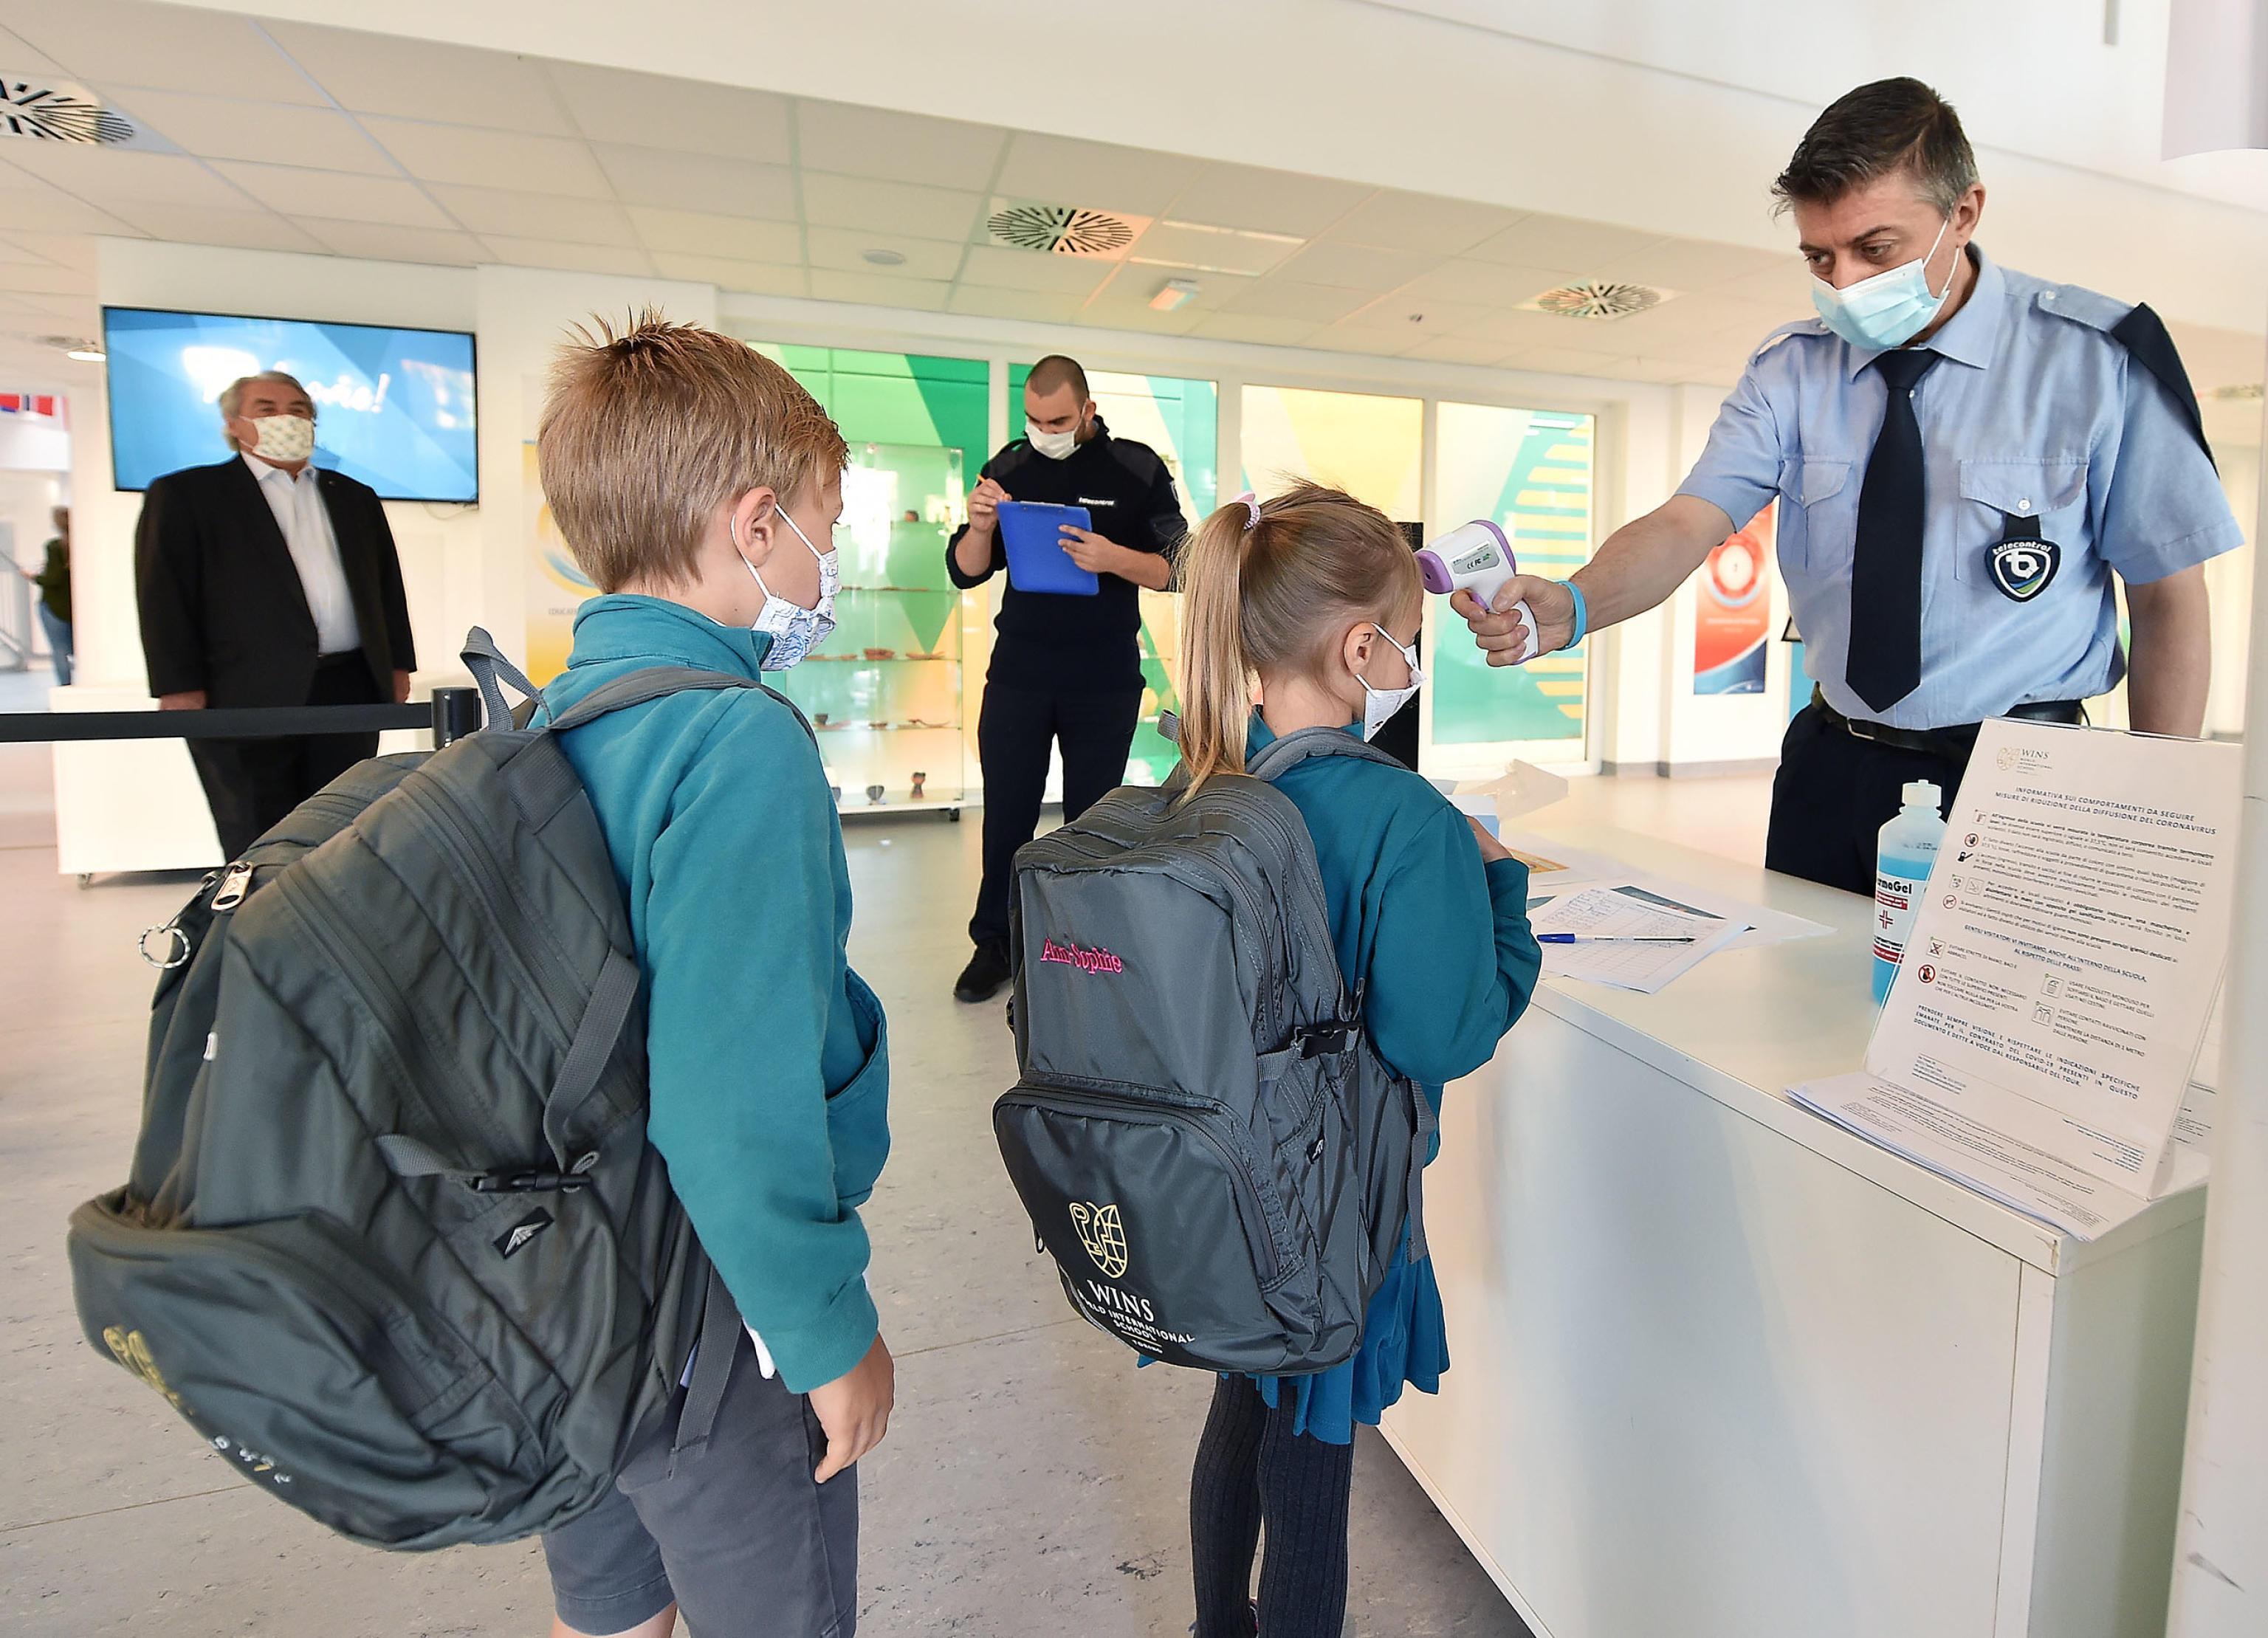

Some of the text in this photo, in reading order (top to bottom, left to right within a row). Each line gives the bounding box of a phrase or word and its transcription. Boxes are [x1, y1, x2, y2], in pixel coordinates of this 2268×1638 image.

[1992, 541, 2052, 555] telecontrol
[2021, 749, 2049, 759] WINS
[1994, 792, 2019, 800] MISURE
[2030, 798, 2067, 808] RIDUZIONE
[2069, 804, 2091, 813] DELLA
[2092, 808, 2137, 821] DIFFUSIONE
[2139, 816, 2154, 824] DEL
[2156, 819, 2216, 834] CORONAVIRUS
[2015, 787, 2063, 799] INFORMATIVA
[2078, 797, 2145, 813] COMPORTAMENTI
[2160, 810, 2195, 821] SEGUIRE
[1040, 937, 1123, 974] Ann-Sophie
[1964, 924, 1982, 933] GENTILI
[1983, 930, 2010, 941] VISITATORI
[2018, 940, 2047, 952] INVITIAMO,
[2048, 949, 2066, 958] ANCHE
[2067, 954, 2103, 968] ALL'INTERNO
[2103, 965, 2121, 974] DELLA
[2122, 970, 2147, 982] SCUOLA,
[2021, 950, 2045, 961] RISPETTO
[2046, 957, 2061, 966] DELLE
[1913, 1017, 1946, 1034] DOCUMENTO
[1951, 1032, 1968, 1042] DETTE
[1975, 1042, 1990, 1051] VOCE
[1992, 1048, 2004, 1056] DAL
[2004, 1053, 2048, 1073] RESPONSABILE
[2049, 1070, 2061, 1078] DEL
[1915, 1011, 1939, 1024] EMANATE
[1969, 1031, 2004, 1048] CONTRASTO
[2009, 1047, 2021, 1055] DEL
[2025, 1053, 2053, 1067] COVID-19
[2059, 1065, 2089, 1081] PRESENTI
[2109, 1084, 2138, 1100] QUESTO
[1917, 1004, 1943, 1017] PRENDERE
[1946, 1015, 1968, 1027] SEMPRE
[1972, 1025, 1995, 1037] VISIONE
[2007, 1038, 2041, 1054] RISPETTARE
[2056, 1056, 2097, 1076] INDICAZIONI
[2100, 1073, 2140, 1092] SPECIFICHE
[2055, 1022, 2082, 1035] MANTENERE
[2089, 1033, 2114, 1046] DISTANZA
[2125, 1046, 2145, 1057] METRO
[1087, 1279, 1154, 1322] WINS
[1108, 1309, 1196, 1344] INTERNATIONAL
[1113, 1319, 1157, 1342] SCHOOL
